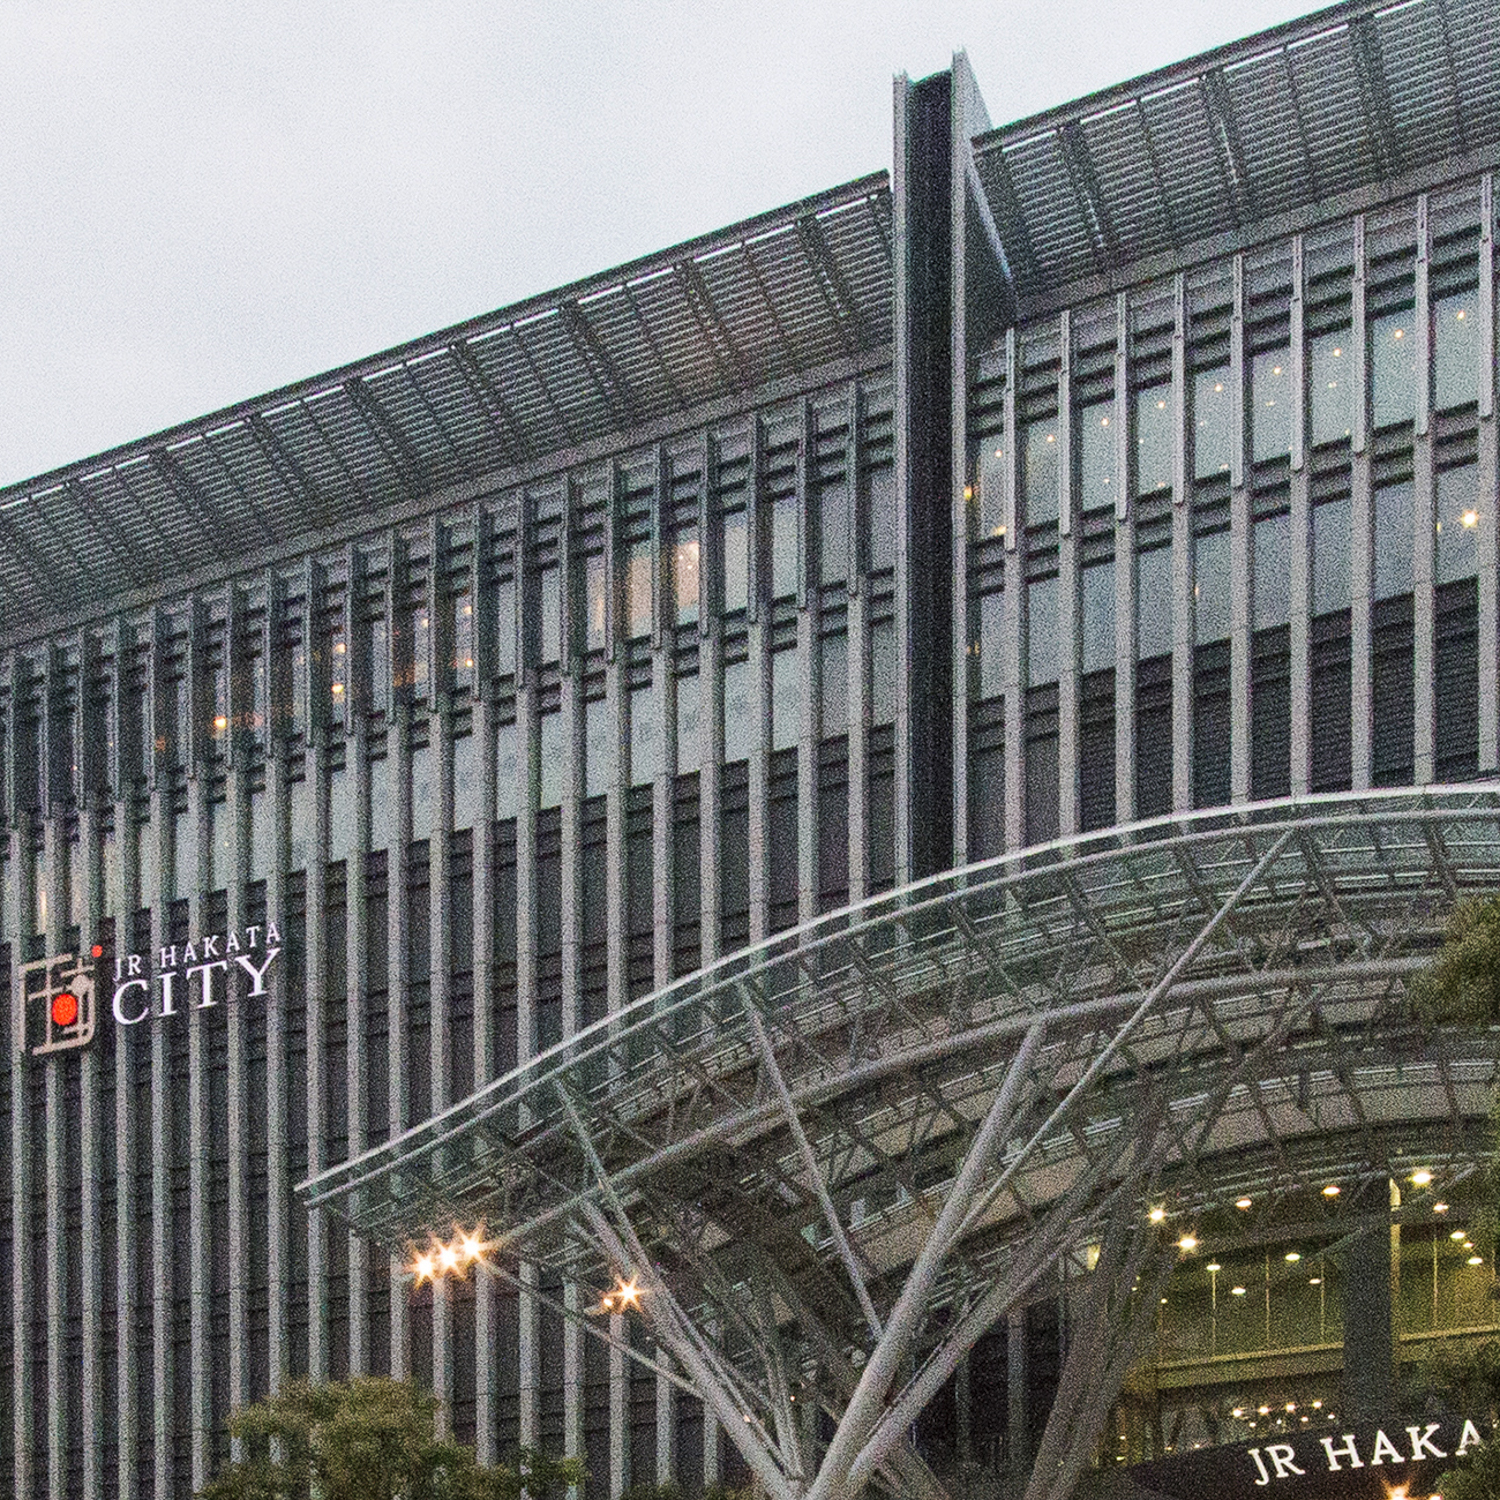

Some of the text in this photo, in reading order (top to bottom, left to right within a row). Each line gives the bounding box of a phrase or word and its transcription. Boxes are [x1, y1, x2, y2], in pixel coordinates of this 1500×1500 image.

[112, 922, 281, 982] JR HAKATA
[112, 947, 282, 1026] CITY
[1248, 1444, 1306, 1486] JR
